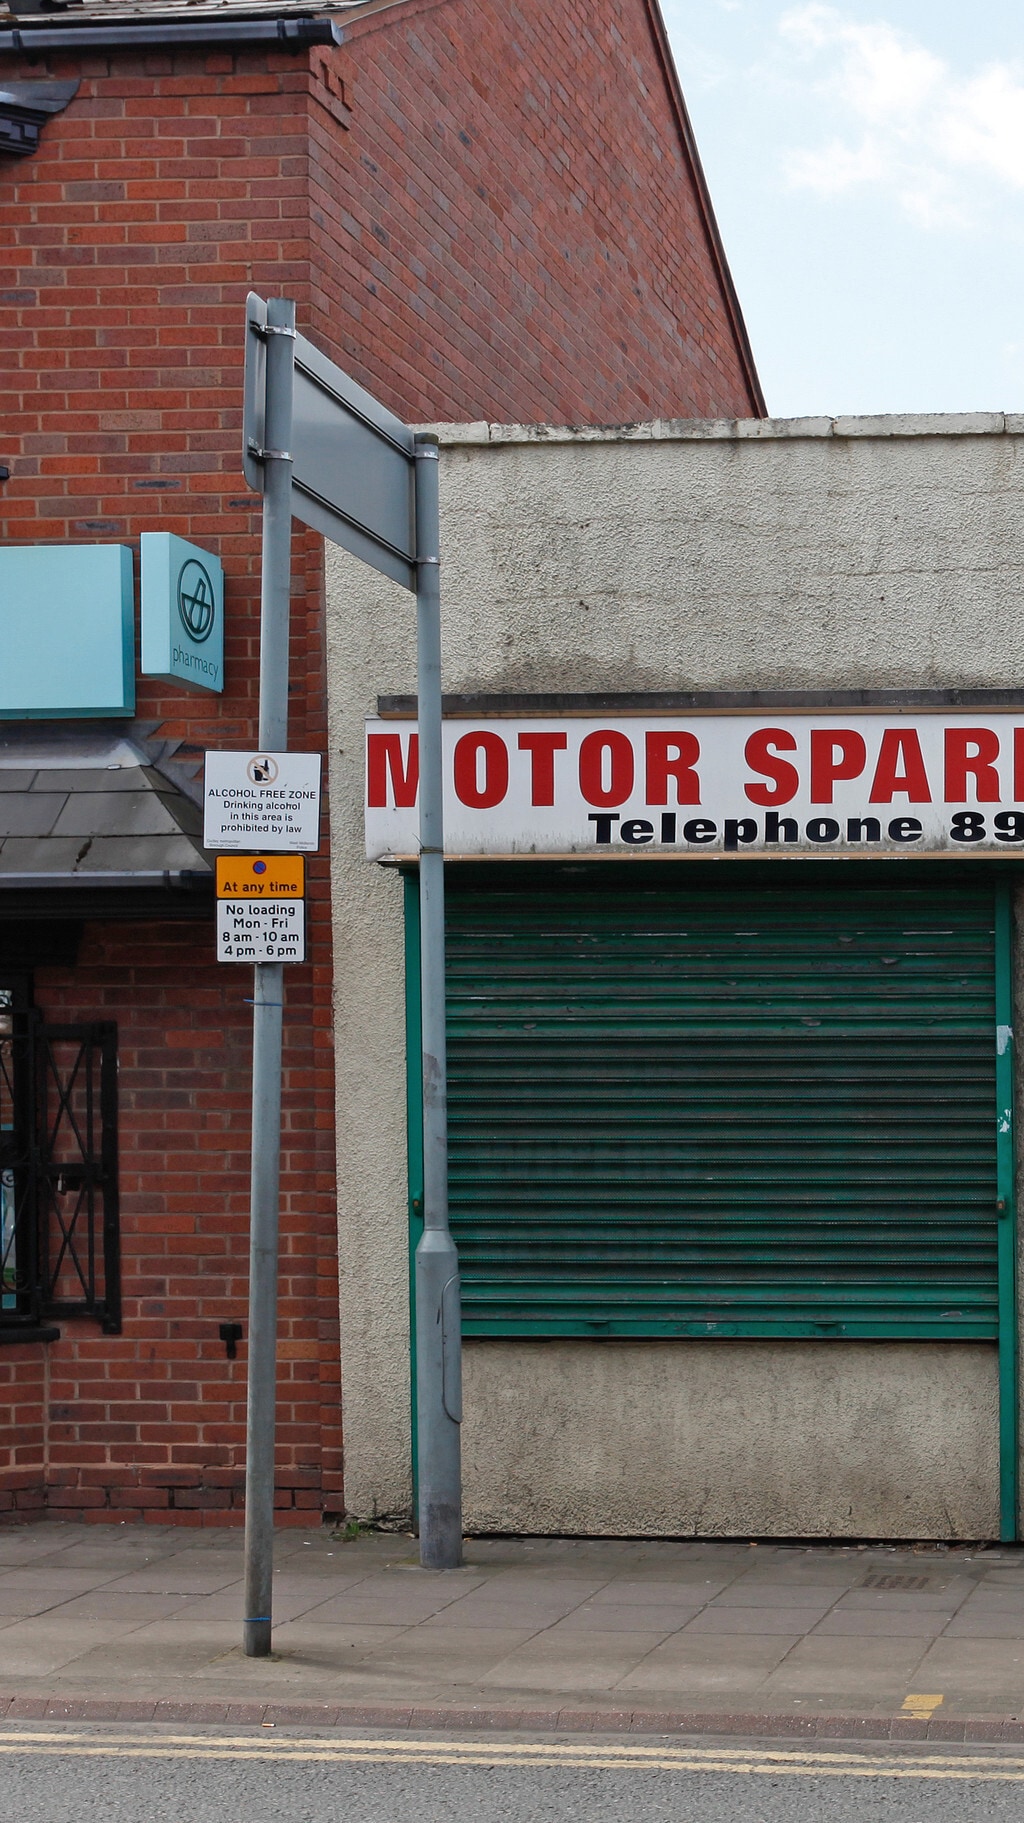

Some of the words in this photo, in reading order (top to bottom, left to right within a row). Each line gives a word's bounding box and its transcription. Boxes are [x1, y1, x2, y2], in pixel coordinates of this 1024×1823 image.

[172, 644, 219, 683] pharmacy
[367, 729, 701, 809] MOTOR
[209, 789, 256, 797] ALCOHOL
[260, 790, 285, 798] FREE
[289, 791, 315, 799] ZONE
[224, 801, 262, 811] Drinking
[266, 802, 300, 810] alcohol
[221, 824, 268, 832] prohibited
[272, 825, 283, 834] by
[587, 810, 924, 851] Telephone
[224, 882, 237, 892] At
[243, 884, 264, 893] any
[270, 882, 297, 891] time
[227, 905, 243, 915] No
[249, 905, 295, 917] loading
[234, 919, 260, 928] Mon
[272, 918, 287, 928] Fri
[223, 932, 230, 942] 8
[263, 932, 277, 941] 10
[225, 946, 232, 955] 4
[237, 948, 255, 957] pm
[267, 945, 274, 955] 6
[278, 948, 296, 957] pm
